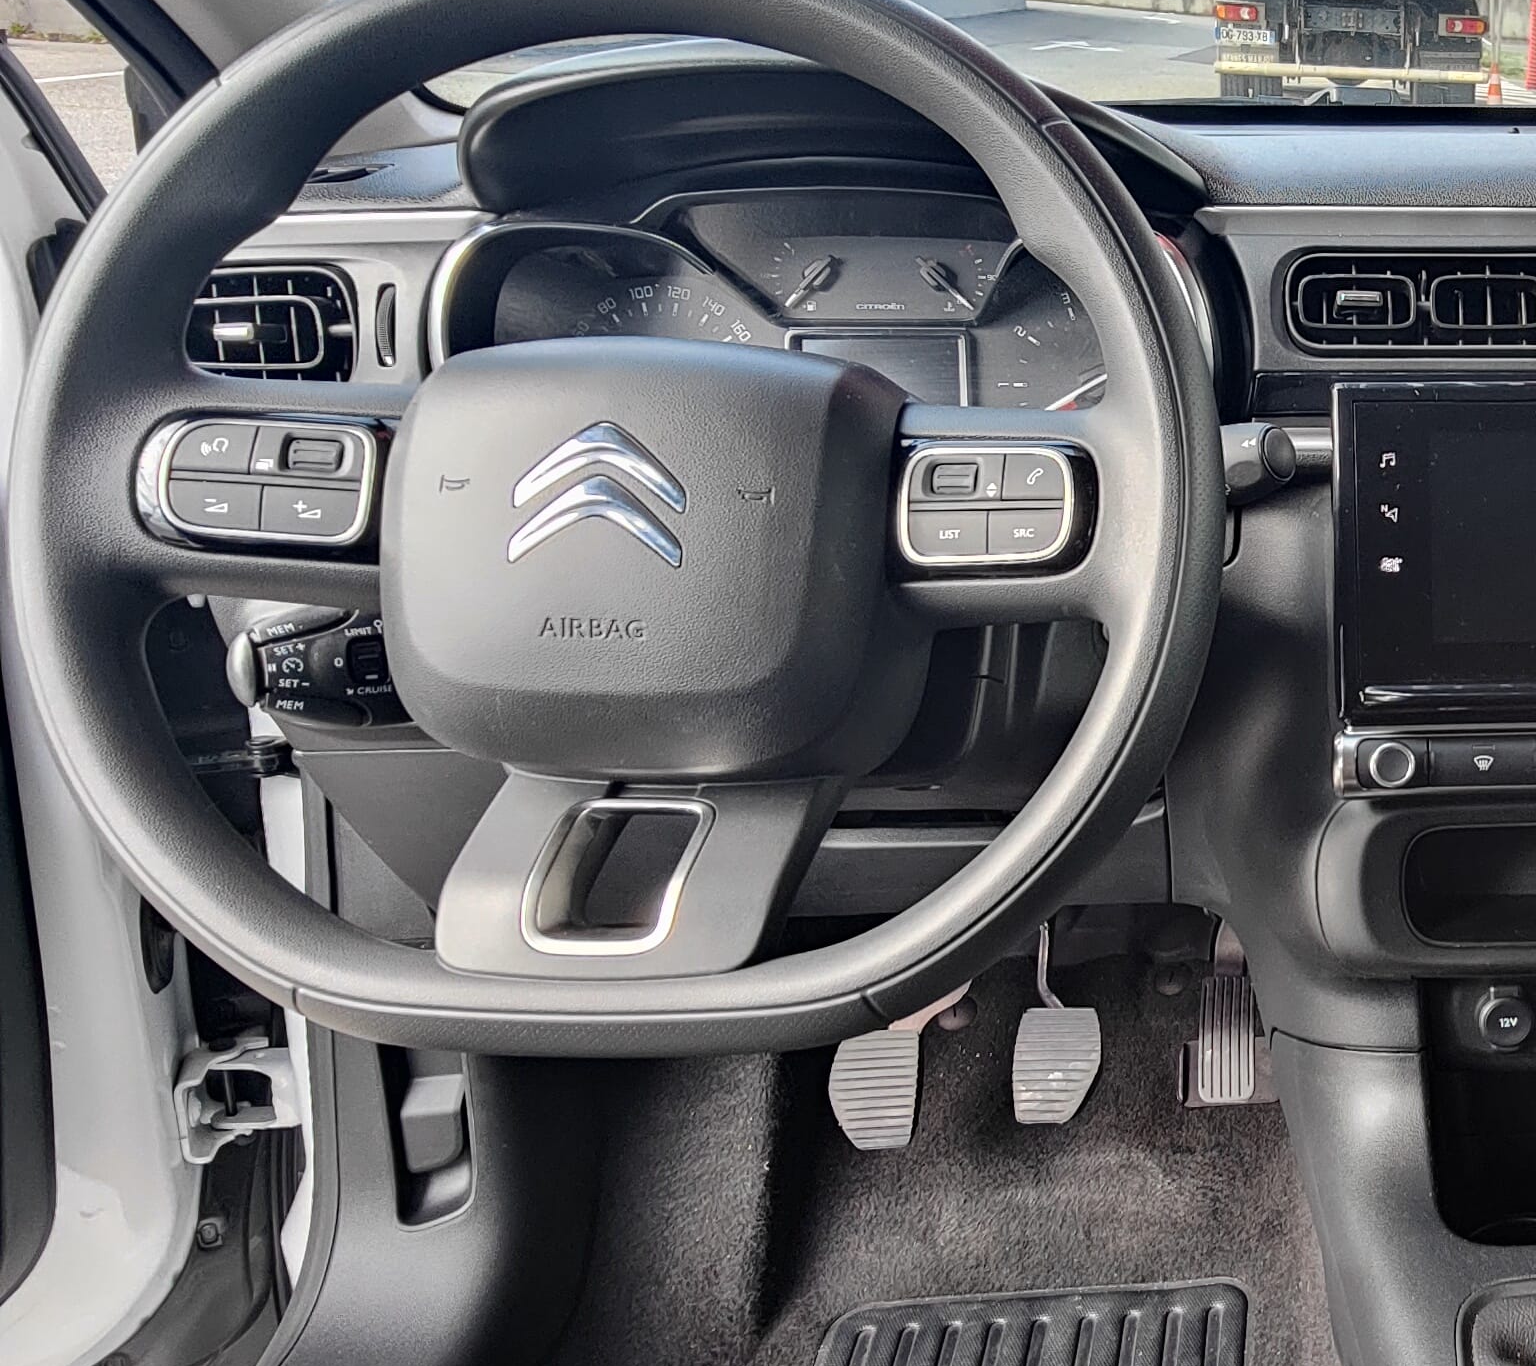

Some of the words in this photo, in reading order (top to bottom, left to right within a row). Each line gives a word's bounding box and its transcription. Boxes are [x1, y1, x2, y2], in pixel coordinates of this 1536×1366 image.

[628, 285, 653, 300] 100
[667, 285, 691, 301] 120
[597, 297, 617, 315] 80
[702, 296, 726, 317] 140
[730, 319, 751, 343] 160
[939, 529, 960, 540] LIST
[1013, 528, 1035, 539] SRC
[266, 622, 296, 637] MEM
[344, 626, 372, 637] LIMIT
[538, 616, 647, 640] AIRBAG
[275, 699, 304, 711] MEM
[1498, 1016, 1518, 1029] 12V
